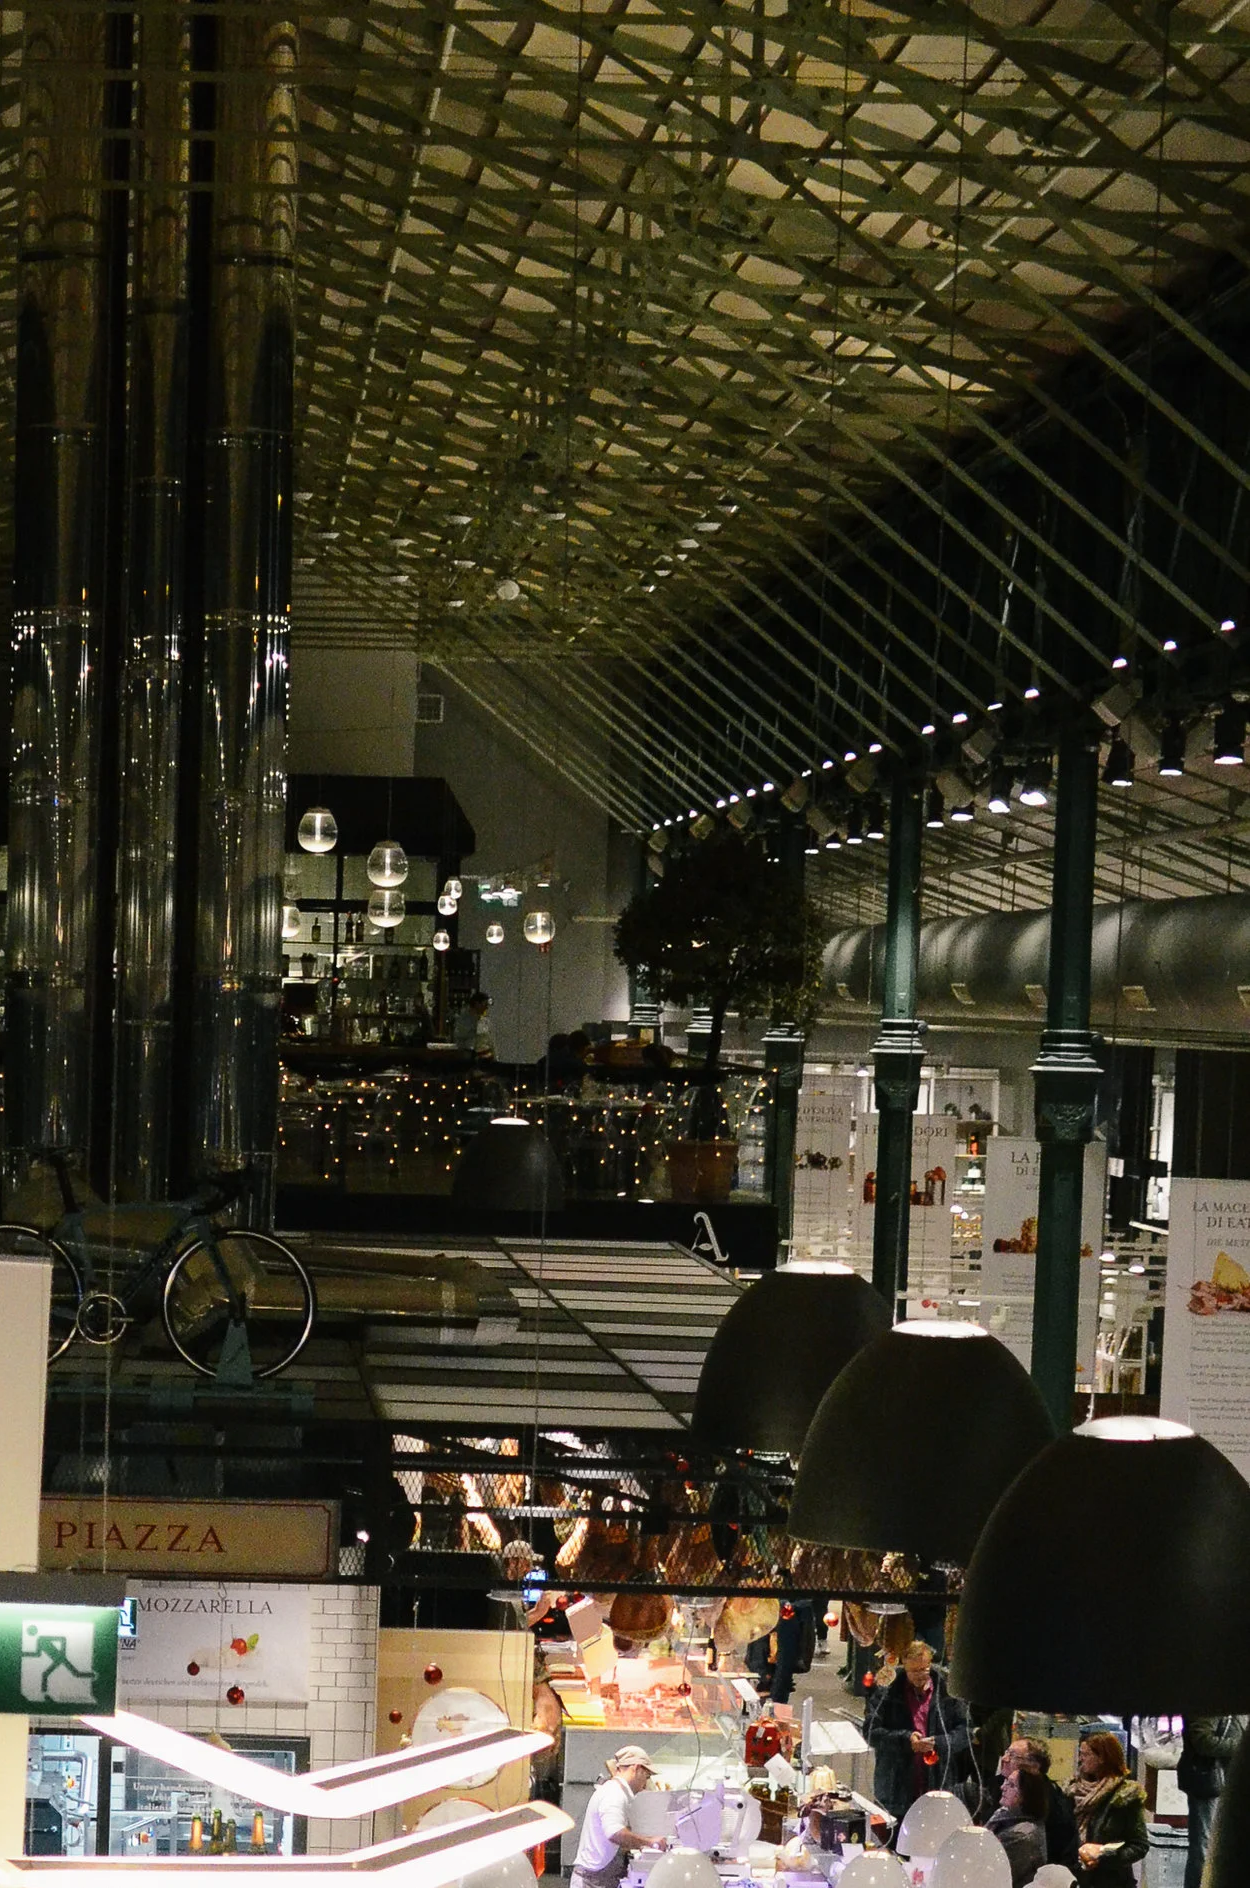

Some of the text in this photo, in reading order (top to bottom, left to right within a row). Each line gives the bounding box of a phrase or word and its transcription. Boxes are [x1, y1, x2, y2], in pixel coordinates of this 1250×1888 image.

[1011, 1151, 1030, 1163] LA
[1193, 1201, 1209, 1212] LA
[54, 1521, 228, 1553] PIAZZA
[138, 1597, 273, 1615] MOZZARELLA
